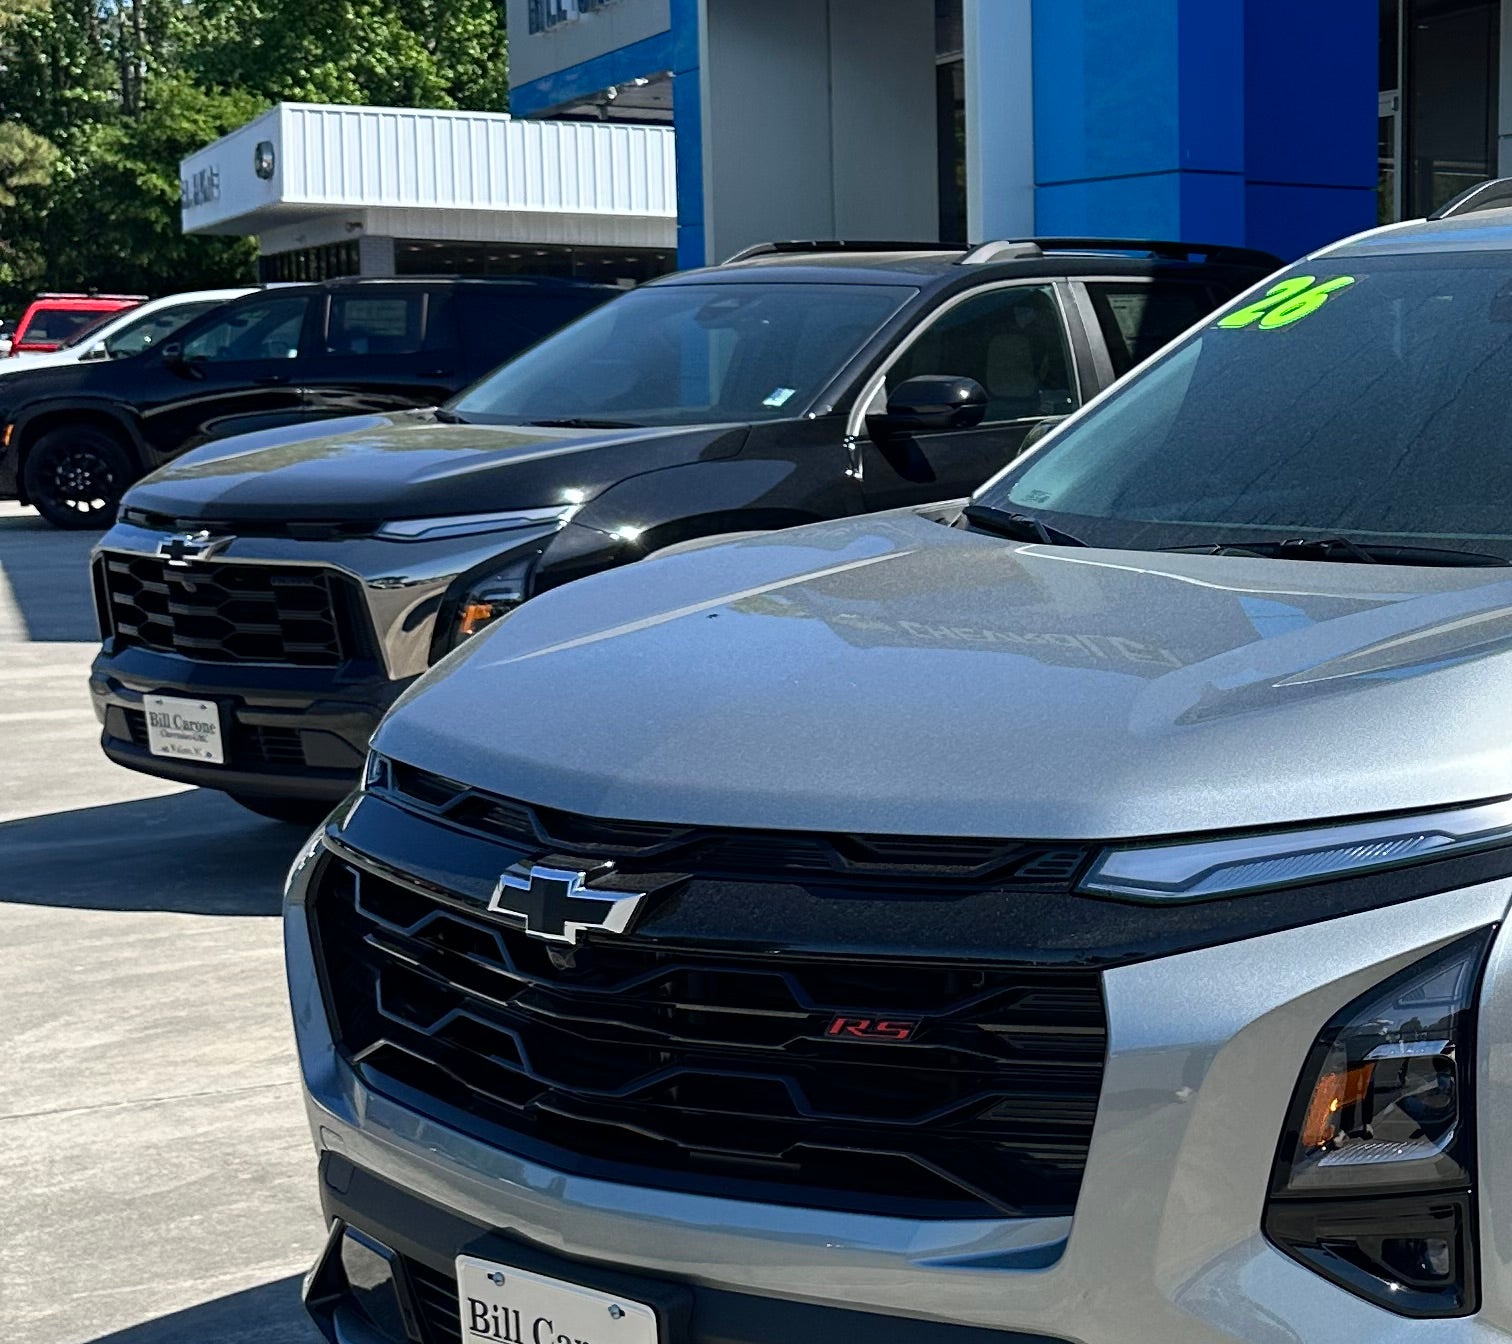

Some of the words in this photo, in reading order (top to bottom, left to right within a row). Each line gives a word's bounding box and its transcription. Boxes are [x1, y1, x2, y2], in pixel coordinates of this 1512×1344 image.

[1217, 276, 1355, 330] 26
[149, 712, 170, 729] Bill
[173, 714, 216, 734] Carone
[829, 1017, 915, 1041] RS
[467, 1297, 523, 1344] Bill
